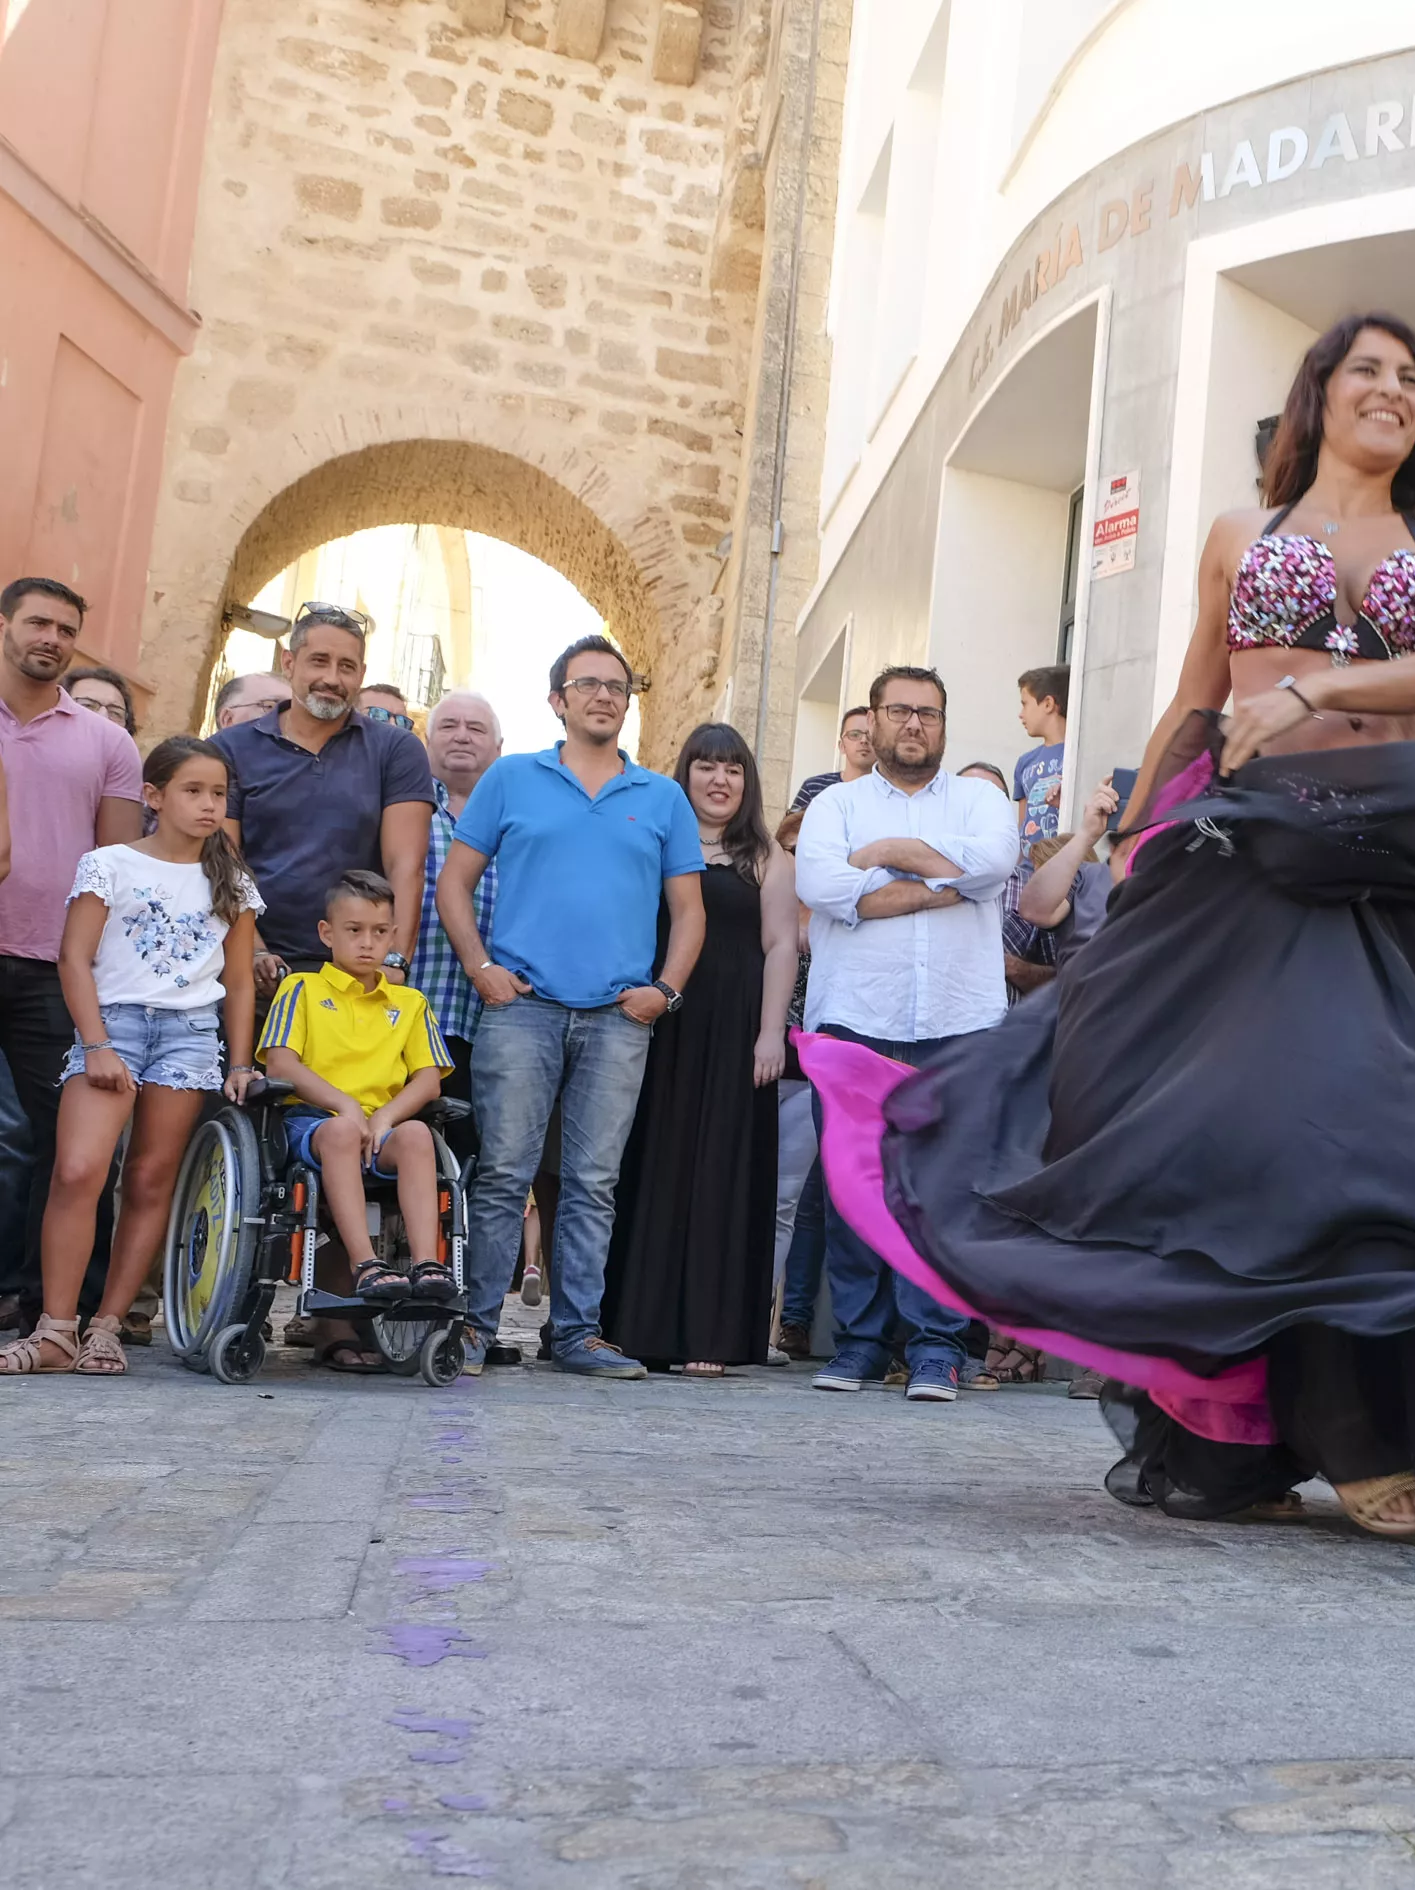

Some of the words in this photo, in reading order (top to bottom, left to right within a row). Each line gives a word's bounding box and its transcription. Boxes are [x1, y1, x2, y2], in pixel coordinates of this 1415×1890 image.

[998, 222, 1084, 347] MARÍA
[1098, 178, 1155, 254] DE
[1095, 515, 1137, 537] Alarma
